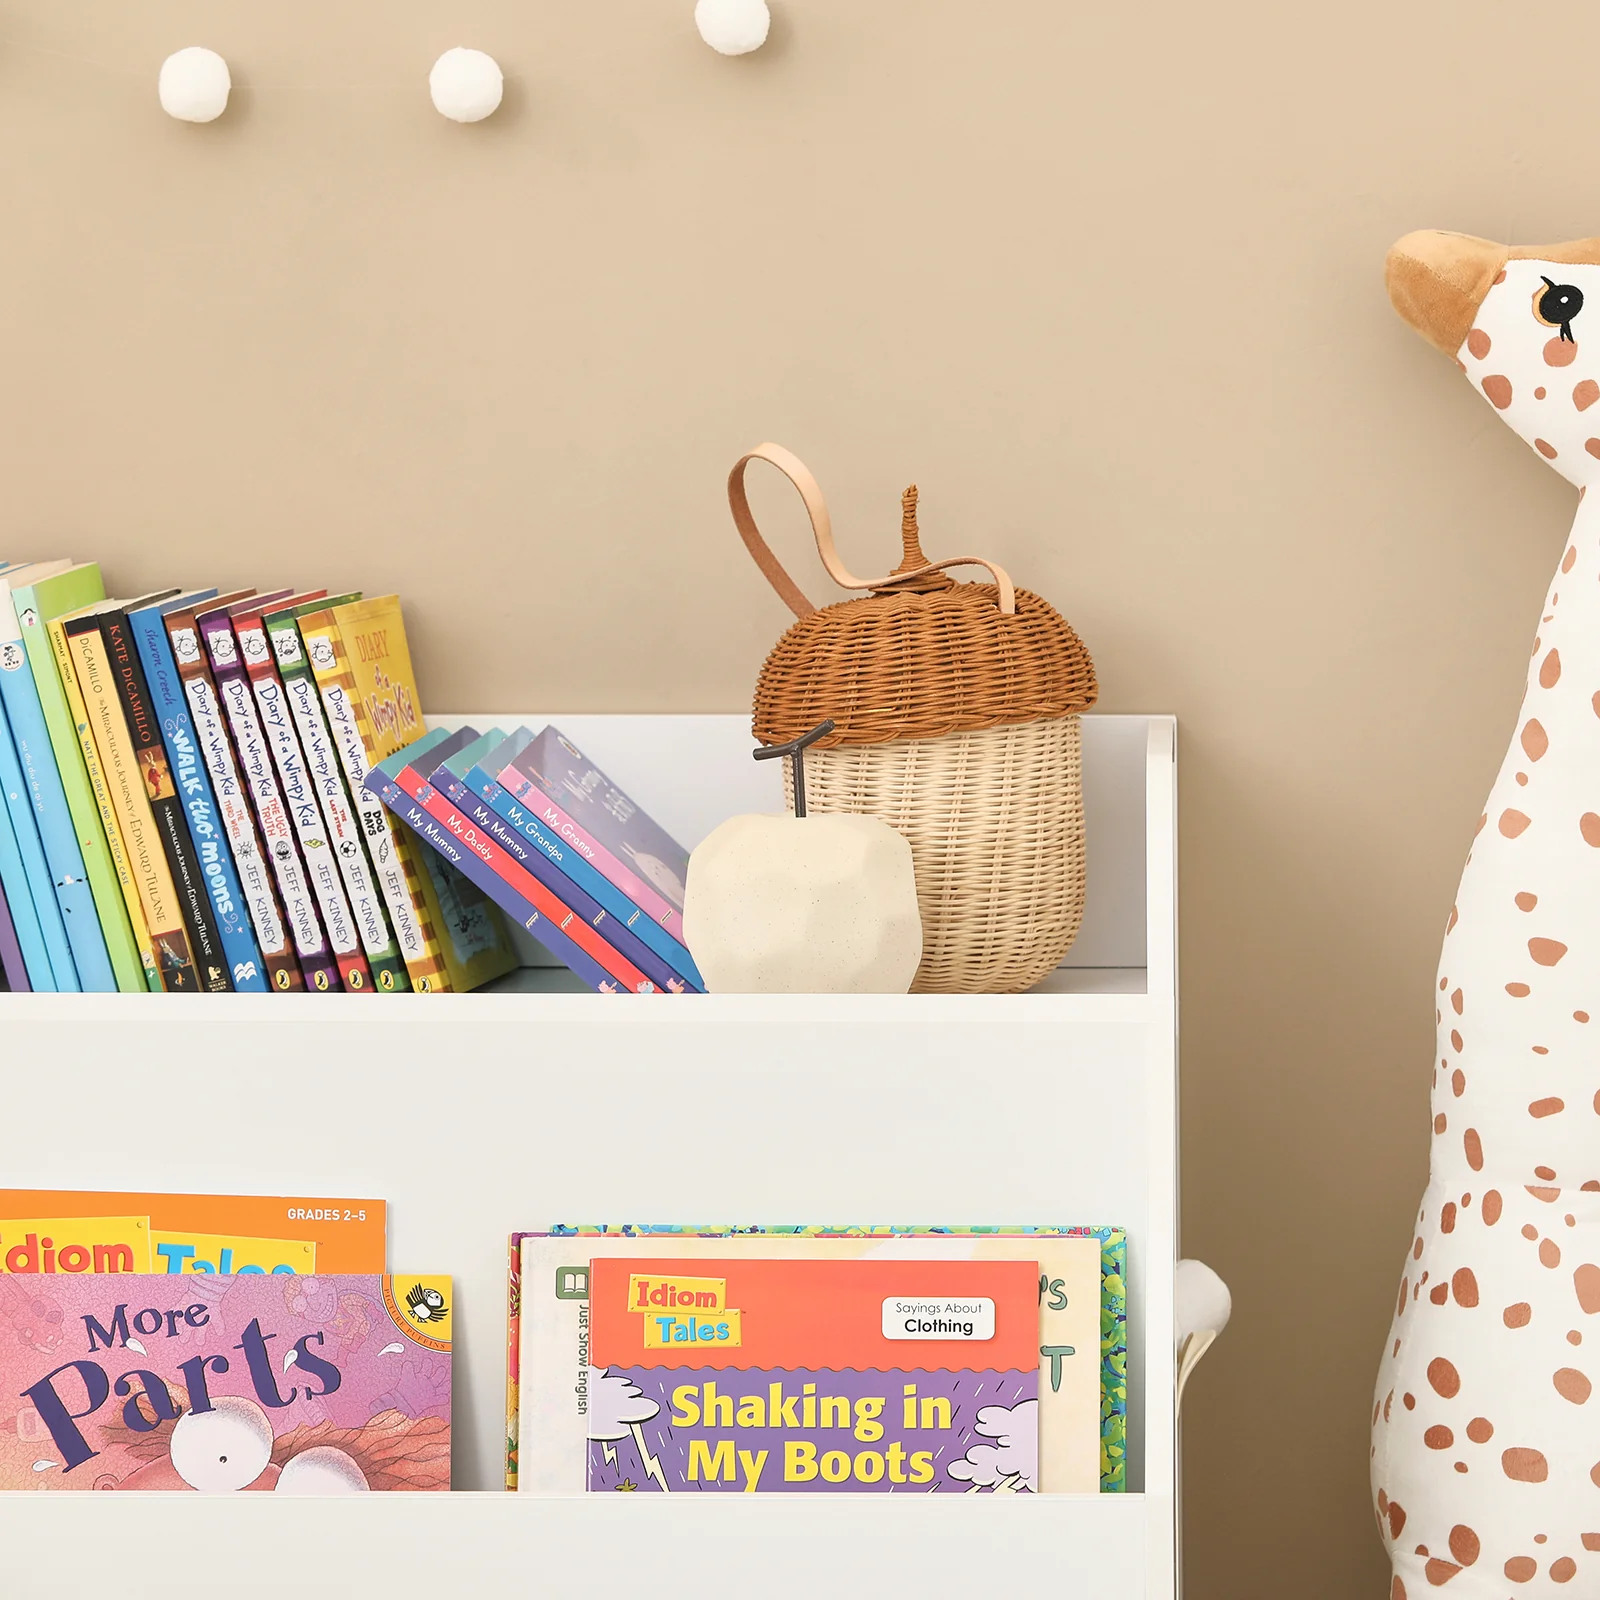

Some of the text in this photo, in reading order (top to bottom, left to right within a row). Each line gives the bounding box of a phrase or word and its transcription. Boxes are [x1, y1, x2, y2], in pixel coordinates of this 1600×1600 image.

[54, 631, 72, 683] SHARMAT SIMONT
[109, 624, 129, 664] KATE
[355, 629, 389, 663] DIARY
[145, 629, 177, 706] Sharon Creech
[191, 681, 212, 716] Diary
[228, 682, 249, 718] Diary
[259, 683, 286, 728] Diary
[293, 681, 314, 717] Diary
[328, 687, 349, 724] Diary
[364, 682, 417, 743] Wimpy Kid
[206, 719, 216, 730] of
[243, 720, 253, 731] of
[278, 731, 291, 744] of
[308, 719, 318, 731] of
[343, 725, 354, 738] of
[209, 737, 227, 775] Wimpy
[247, 738, 264, 778] Wimpy
[311, 738, 330, 777] Wimpy
[347, 744, 365, 783] Wimpy
[32, 781, 39, 791] de
[220, 776, 235, 796] Kid
[258, 777, 272, 797] Kid
[282, 753, 305, 802] Wimpy
[322, 775, 338, 796] Kid
[83, 740, 129, 885] NATE THE GREAT AND THE STICKY CASE
[99, 706, 122, 769] MIRACULOUS
[117, 769, 135, 812] JOURNEY
[130, 818, 152, 873] EDWARD
[145, 872, 166, 923] TULANE
[173, 728, 234, 914] WALK two moons
[224, 799, 241, 839] THIRD WHEEL
[236, 809, 245, 821] THE
[261, 806, 276, 837] TRUTH
[268, 797, 289, 838] THE UGLY
[296, 802, 316, 828] Kid
[329, 799, 338, 815] LAST
[363, 811, 377, 836] DAYS
[373, 810, 386, 833] DOG
[407, 808, 461, 863] My Mummy
[447, 814, 493, 861] My Daddy
[473, 806, 528, 860] My Mummy
[507, 807, 563, 861] My Grandpa
[543, 807, 595, 859] My Granny
[187, 888, 203, 925] EDWARD
[197, 922, 213, 956] TULANE
[245, 864, 278, 946] JEFF KINNEY
[283, 865, 316, 947] JEFF KINNEY
[317, 864, 350, 945] JEFF KINNEY
[350, 864, 382, 946] JEFF KINNEY
[385, 870, 419, 953] JEFF KINNEY
[287, 1208, 341, 1221] GRADES
[0, 1233, 134, 1274] diom
[637, 1281, 718, 1308] Idiom
[895, 1302, 982, 1316] Sayings About
[81, 1303, 210, 1352] More
[384, 1288, 446, 1349] PICTURE PUFFINS
[655, 1316, 730, 1343] Tales
[904, 1318, 974, 1336] Clothing
[574, 1304, 589, 1415] Just Show English
[20, 1317, 342, 1473] Parts
[671, 1381, 952, 1441] Shaking in
[687, 1440, 935, 1492] My Boots
